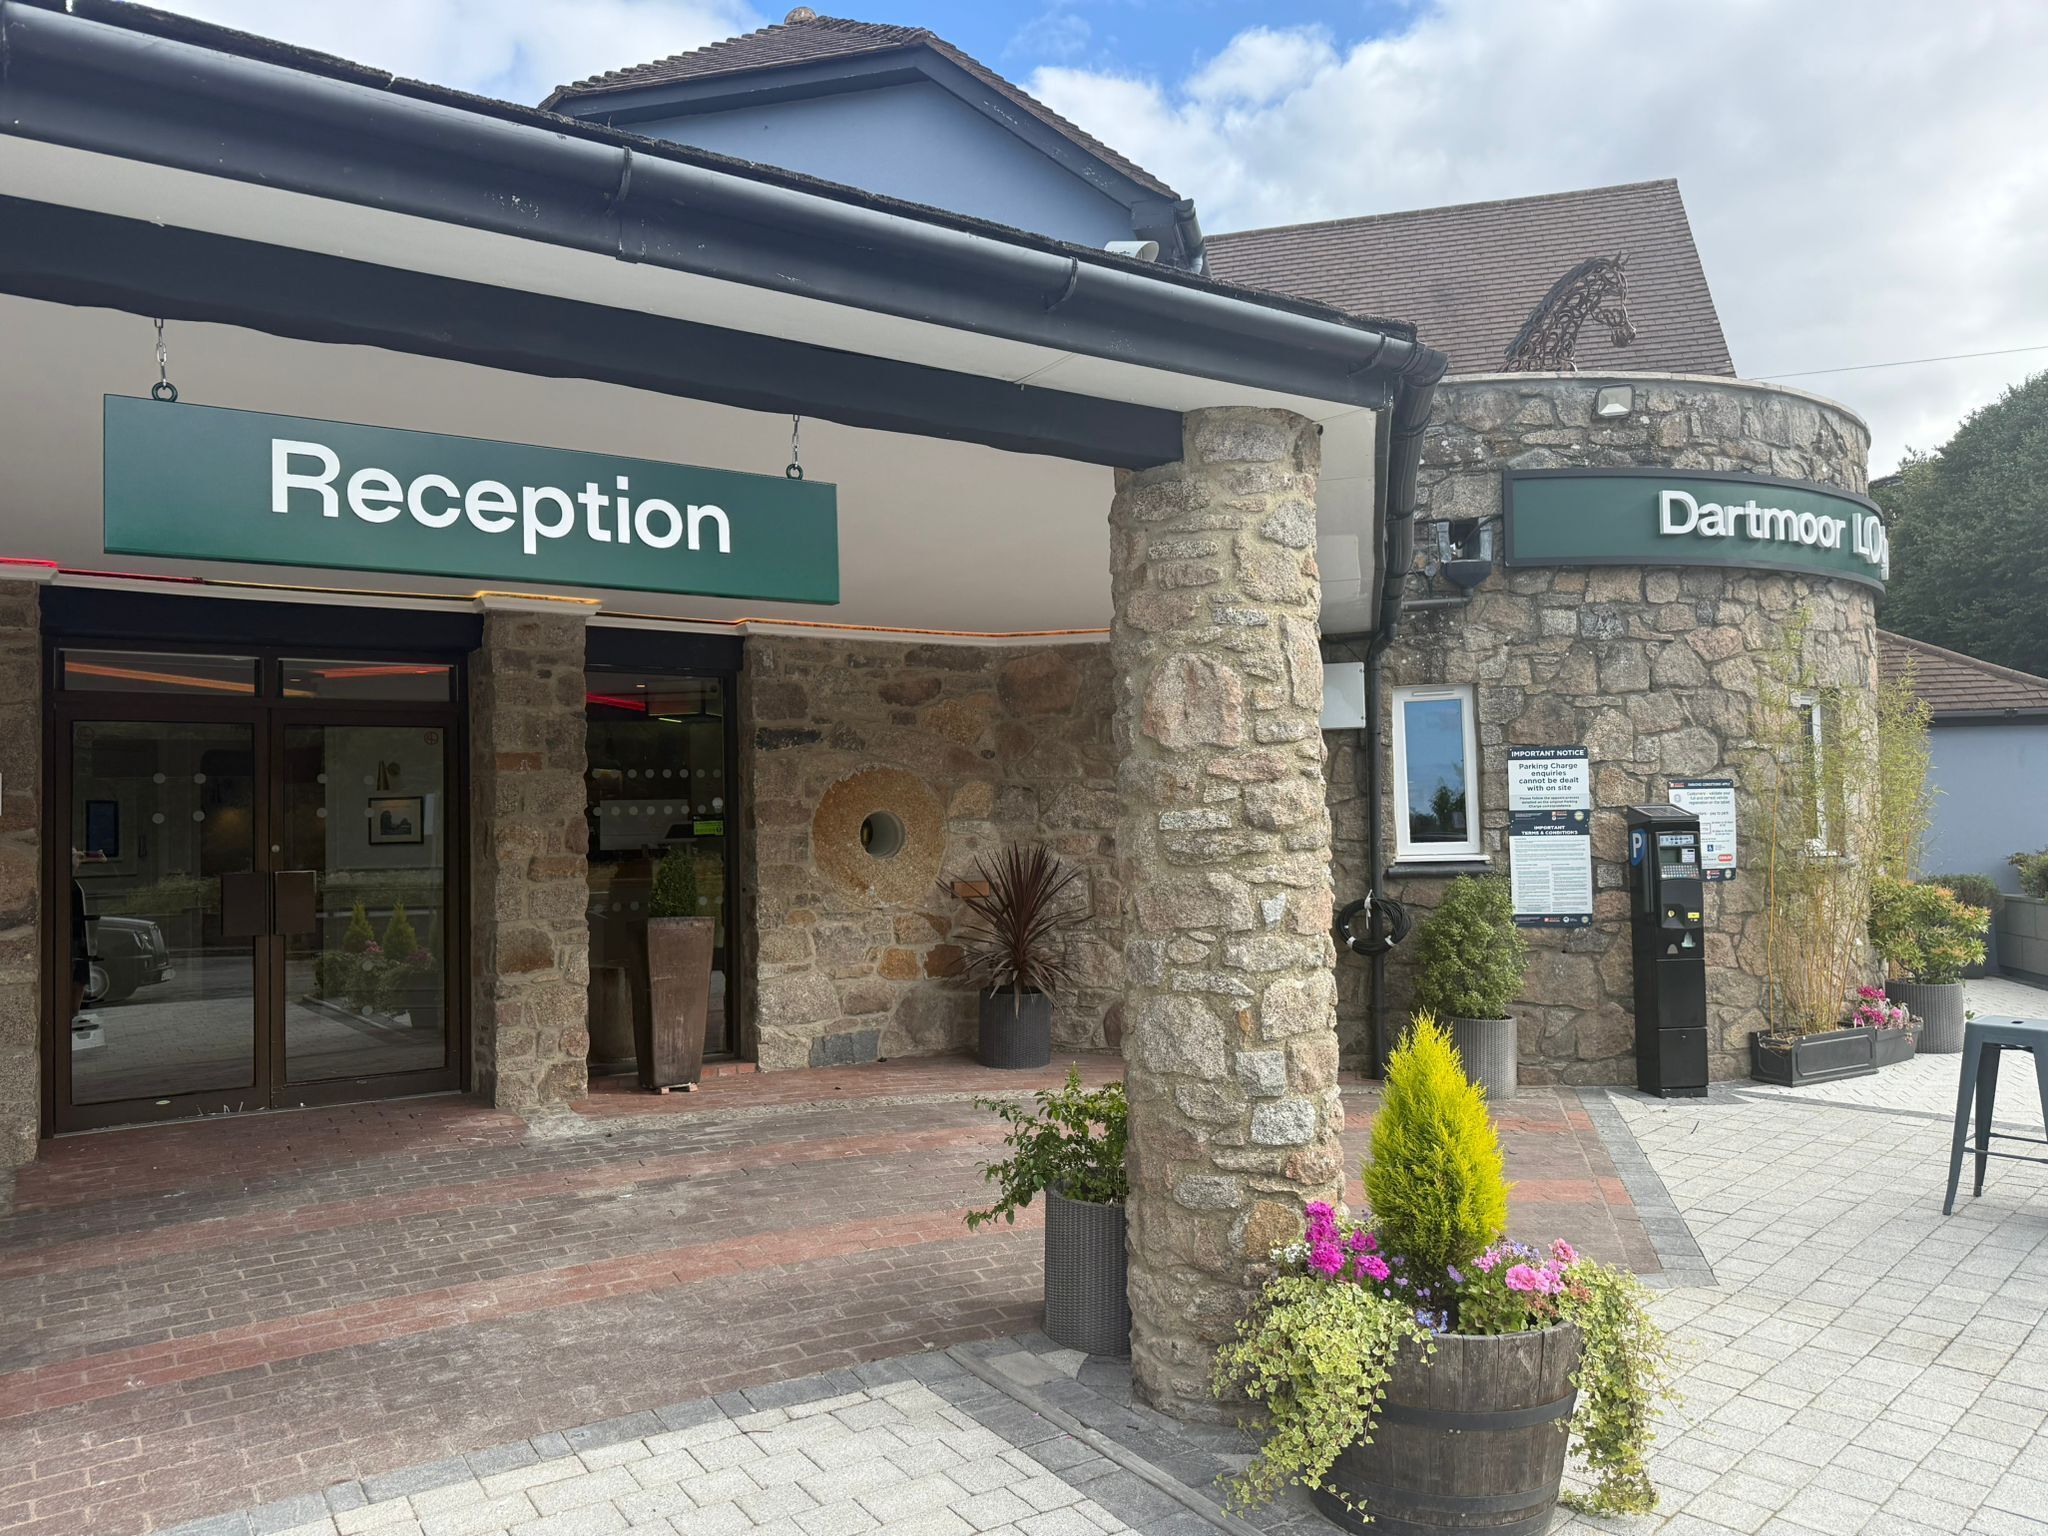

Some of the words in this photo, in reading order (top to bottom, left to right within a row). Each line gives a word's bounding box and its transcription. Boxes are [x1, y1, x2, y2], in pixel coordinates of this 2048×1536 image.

[271, 437, 732, 556] Reception
[1658, 489, 1846, 549] Dartmoor
[1518, 763, 1549, 771] Parking
[1550, 762, 1578, 770] Charge
[1632, 832, 1643, 859] P
